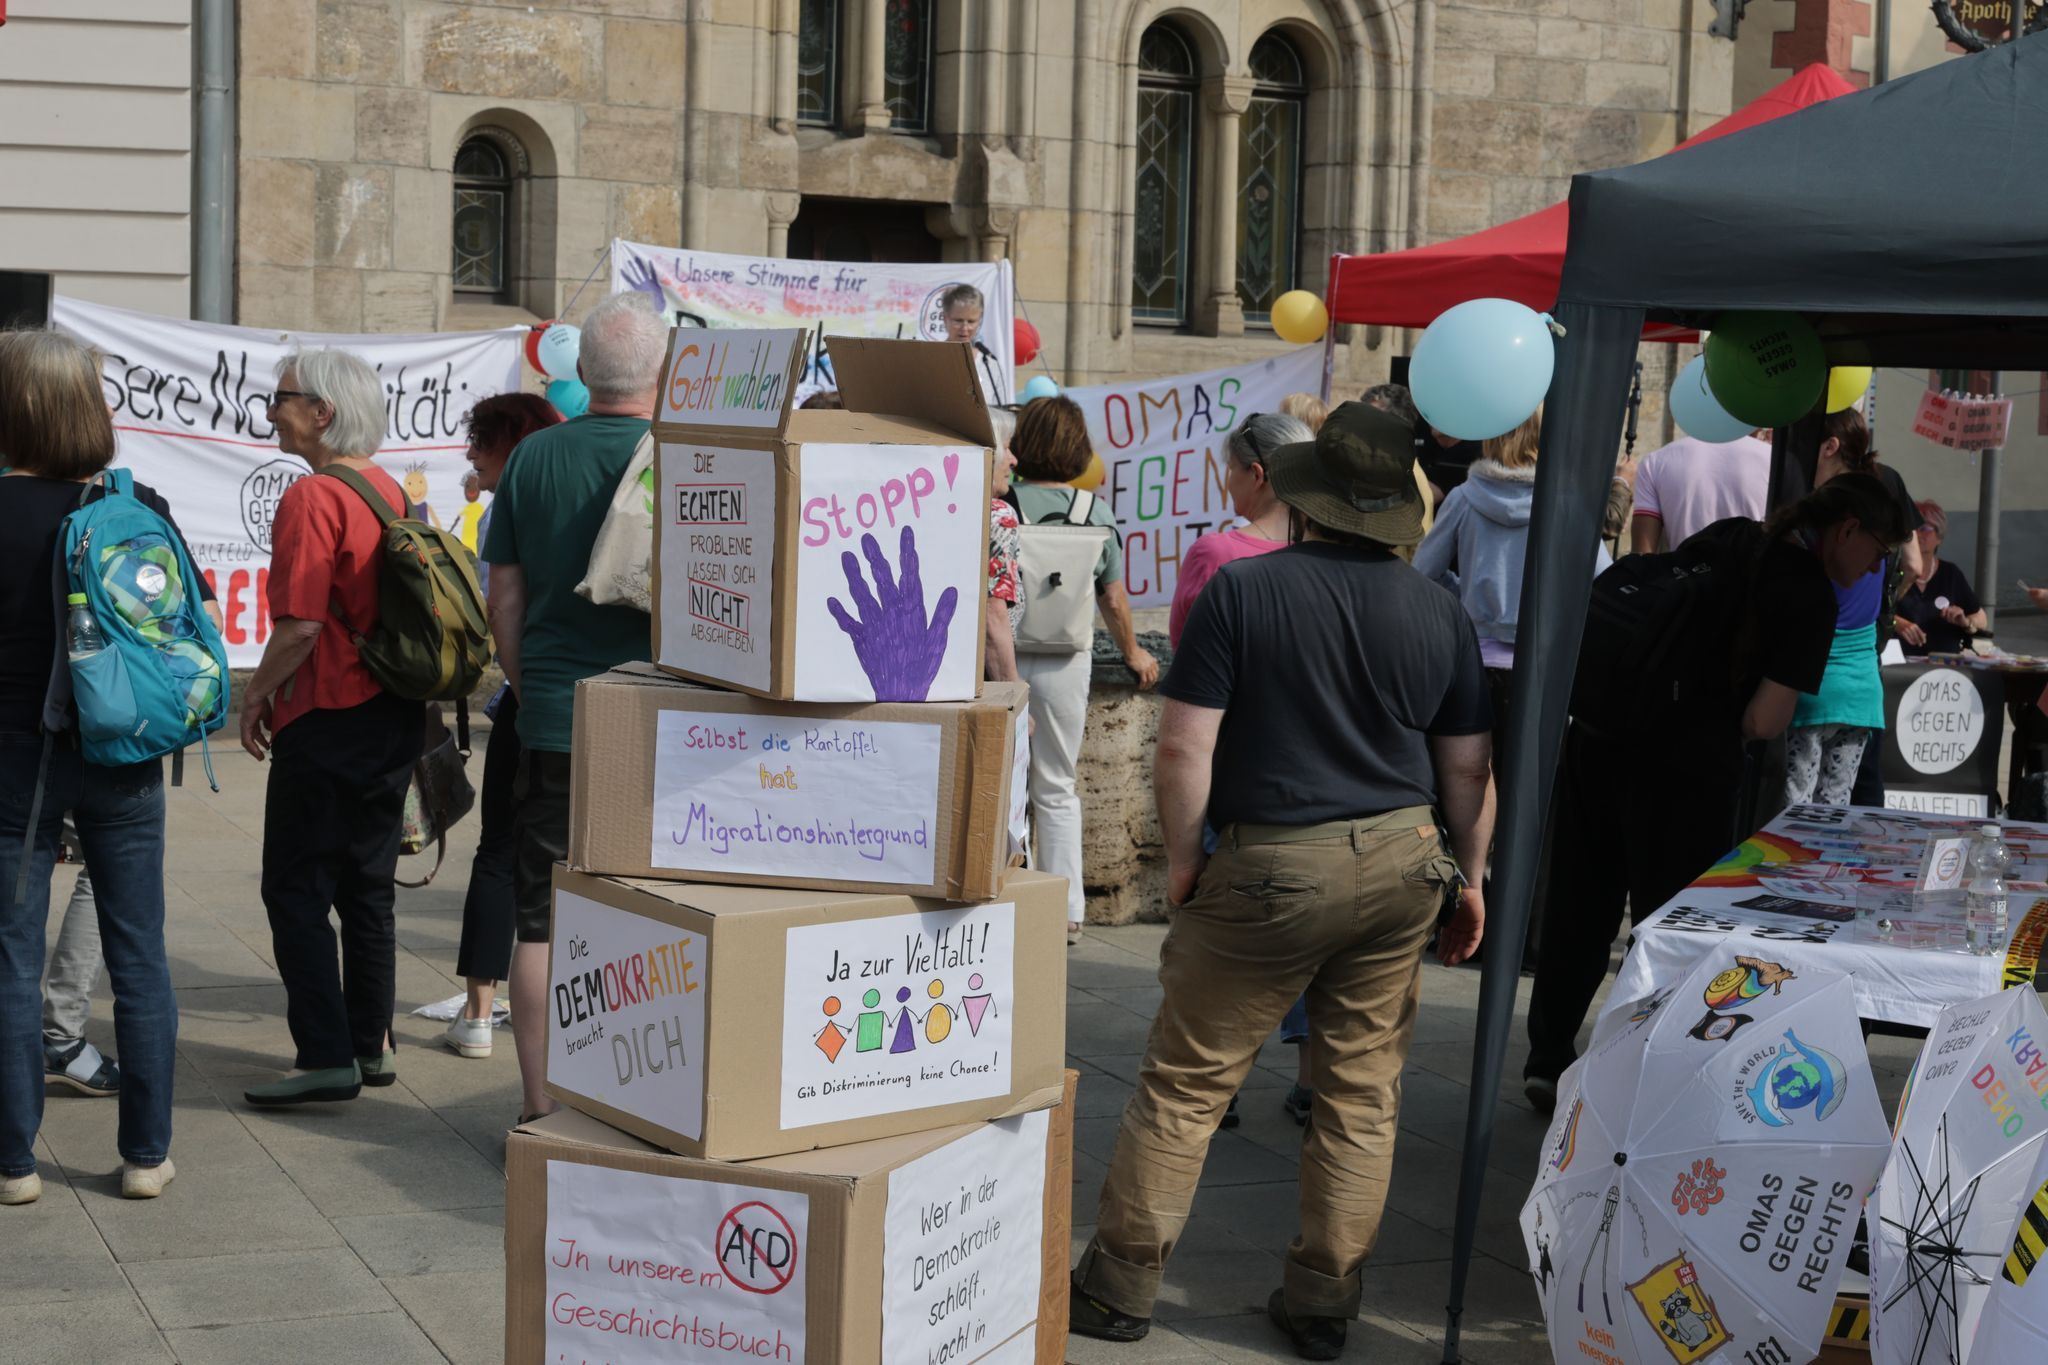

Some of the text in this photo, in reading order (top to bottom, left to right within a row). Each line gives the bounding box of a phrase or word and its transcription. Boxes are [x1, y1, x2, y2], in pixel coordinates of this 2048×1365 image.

[1960, 0, 2037, 25] Apothe
[674, 257, 867, 293] Unsere Stimme für
[100, 353, 202, 426] sere
[668, 341, 729, 412] Geht
[1104, 377, 1241, 449] OMAS
[693, 452, 715, 474] DIE
[802, 453, 960, 547] Stopp!
[1098, 447, 1233, 524] EGEN
[679, 489, 742, 522] ECHTEN
[190, 542, 253, 563] AALFELD
[690, 535, 753, 556] PROBLEME
[687, 561, 756, 584] LASSEN SICH
[691, 585, 745, 628] NICHT
[691, 623, 755, 654] ABSCHIEBEN
[1919, 681, 1961, 702] OMAS
[1911, 712, 1971, 733] GEGEN
[683, 725, 879, 760] Selbst die Kartoffel
[1912, 742, 1966, 763] RECHTS
[759, 762, 798, 790] hat
[672, 802, 928, 861] Migrationshintergrund
[569, 934, 590, 961] Die
[555, 937, 698, 1029] DEMOKRATIE
[826, 949, 851, 983] Ja
[860, 957, 895, 978] zur
[565, 1021, 605, 1056] braucht
[611, 1015, 687, 1086] DICH
[797, 1085, 817, 1100] Gib
[822, 1071, 911, 1096] Diskriminierung
[920, 1065, 944, 1081] keine
[1733, 1046, 1776, 1124] SAVE THE WORLD
[920, 1174, 998, 1236] Wer in der
[1740, 1173, 1783, 1253] OMAS
[1768, 1175, 1819, 1273] GEGEN
[1797, 1181, 1853, 1294] RECHTS
[722, 1223, 790, 1279] AfD
[913, 1215, 1001, 1292] Demokratie
[608, 1255, 722, 1289] unserem
[552, 1292, 791, 1362] Geschichtsbuch
[975, 1318, 986, 1343] in
[1584, 1320, 1616, 1351] kein
